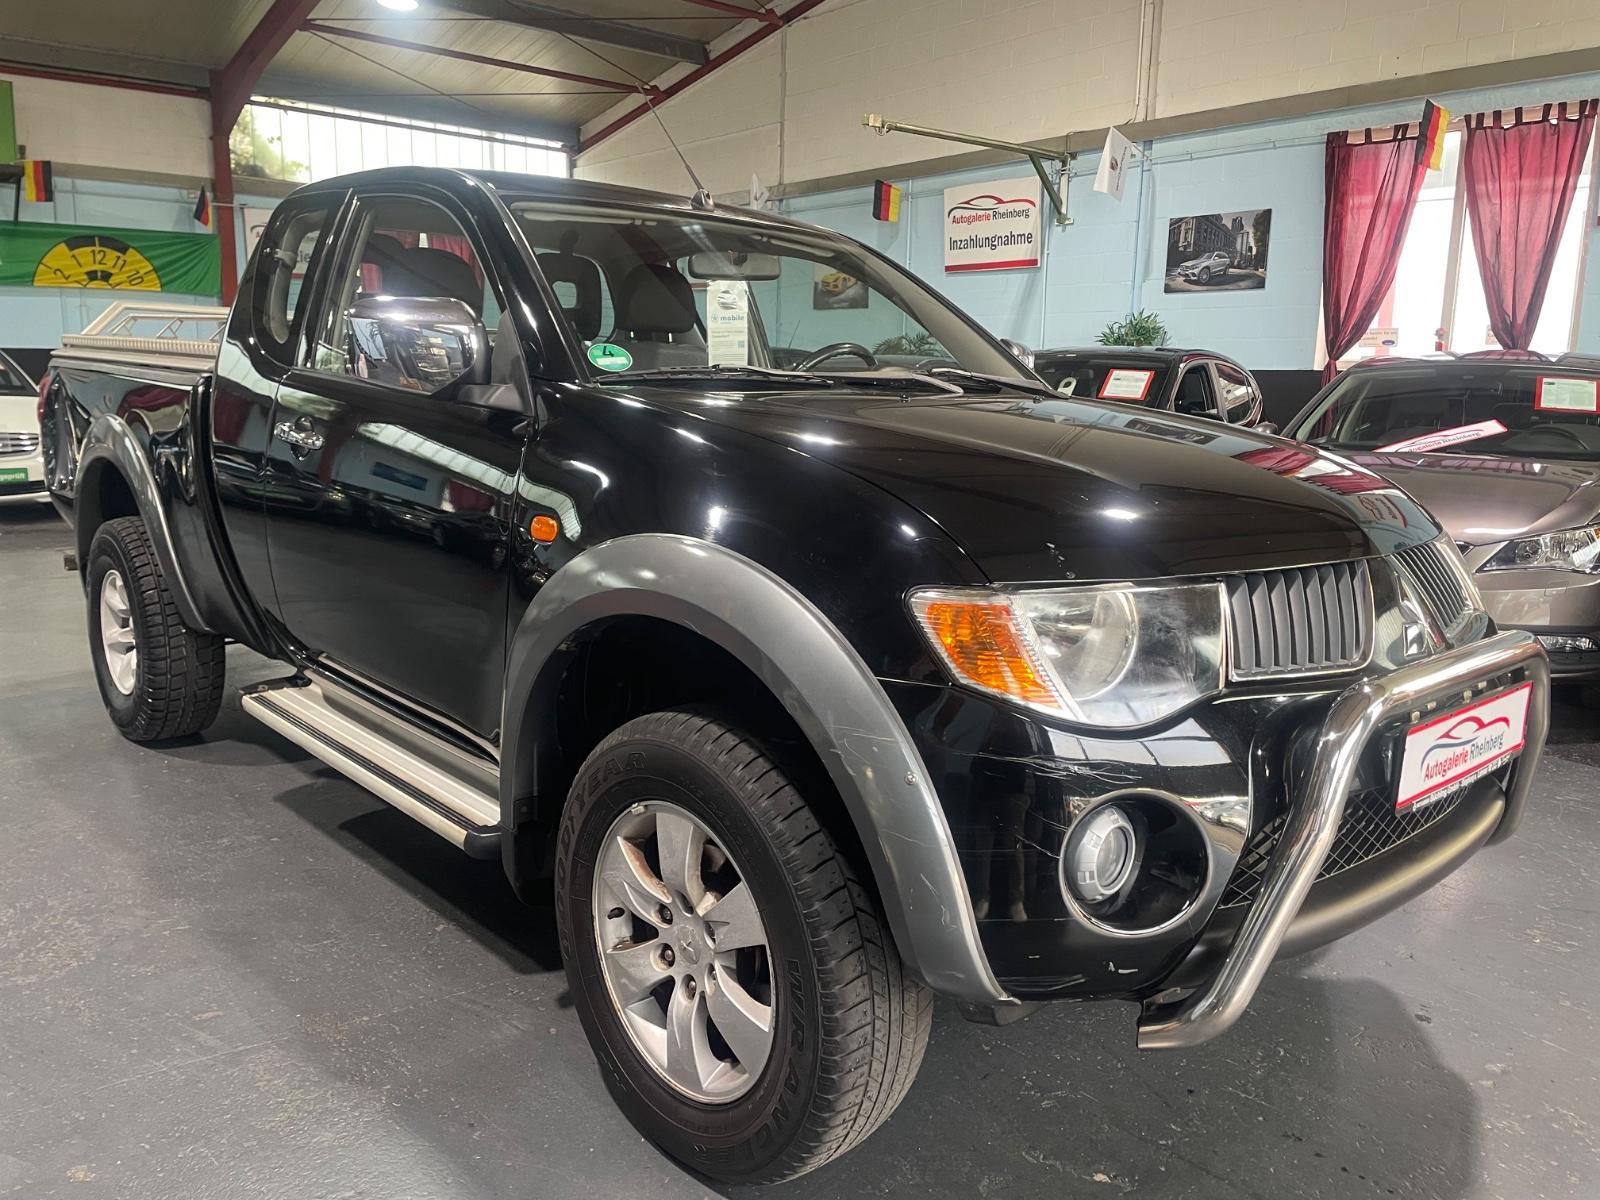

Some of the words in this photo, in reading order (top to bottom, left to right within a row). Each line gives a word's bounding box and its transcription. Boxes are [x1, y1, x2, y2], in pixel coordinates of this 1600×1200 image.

[952, 211, 991, 226] Autogalerie
[992, 207, 1030, 221] Rheinberg
[949, 231, 1033, 252] Inzahlungnahme
[53, 268, 71, 281] 2
[71, 254, 82, 268] 1
[90, 249, 107, 266] 12
[112, 255, 127, 272] 11
[126, 270, 145, 287] 10
[1425, 749, 1468, 781] Autogalerie
[1470, 732, 1504, 760] Rheinberg
[556, 751, 648, 962] GOODYEAR
